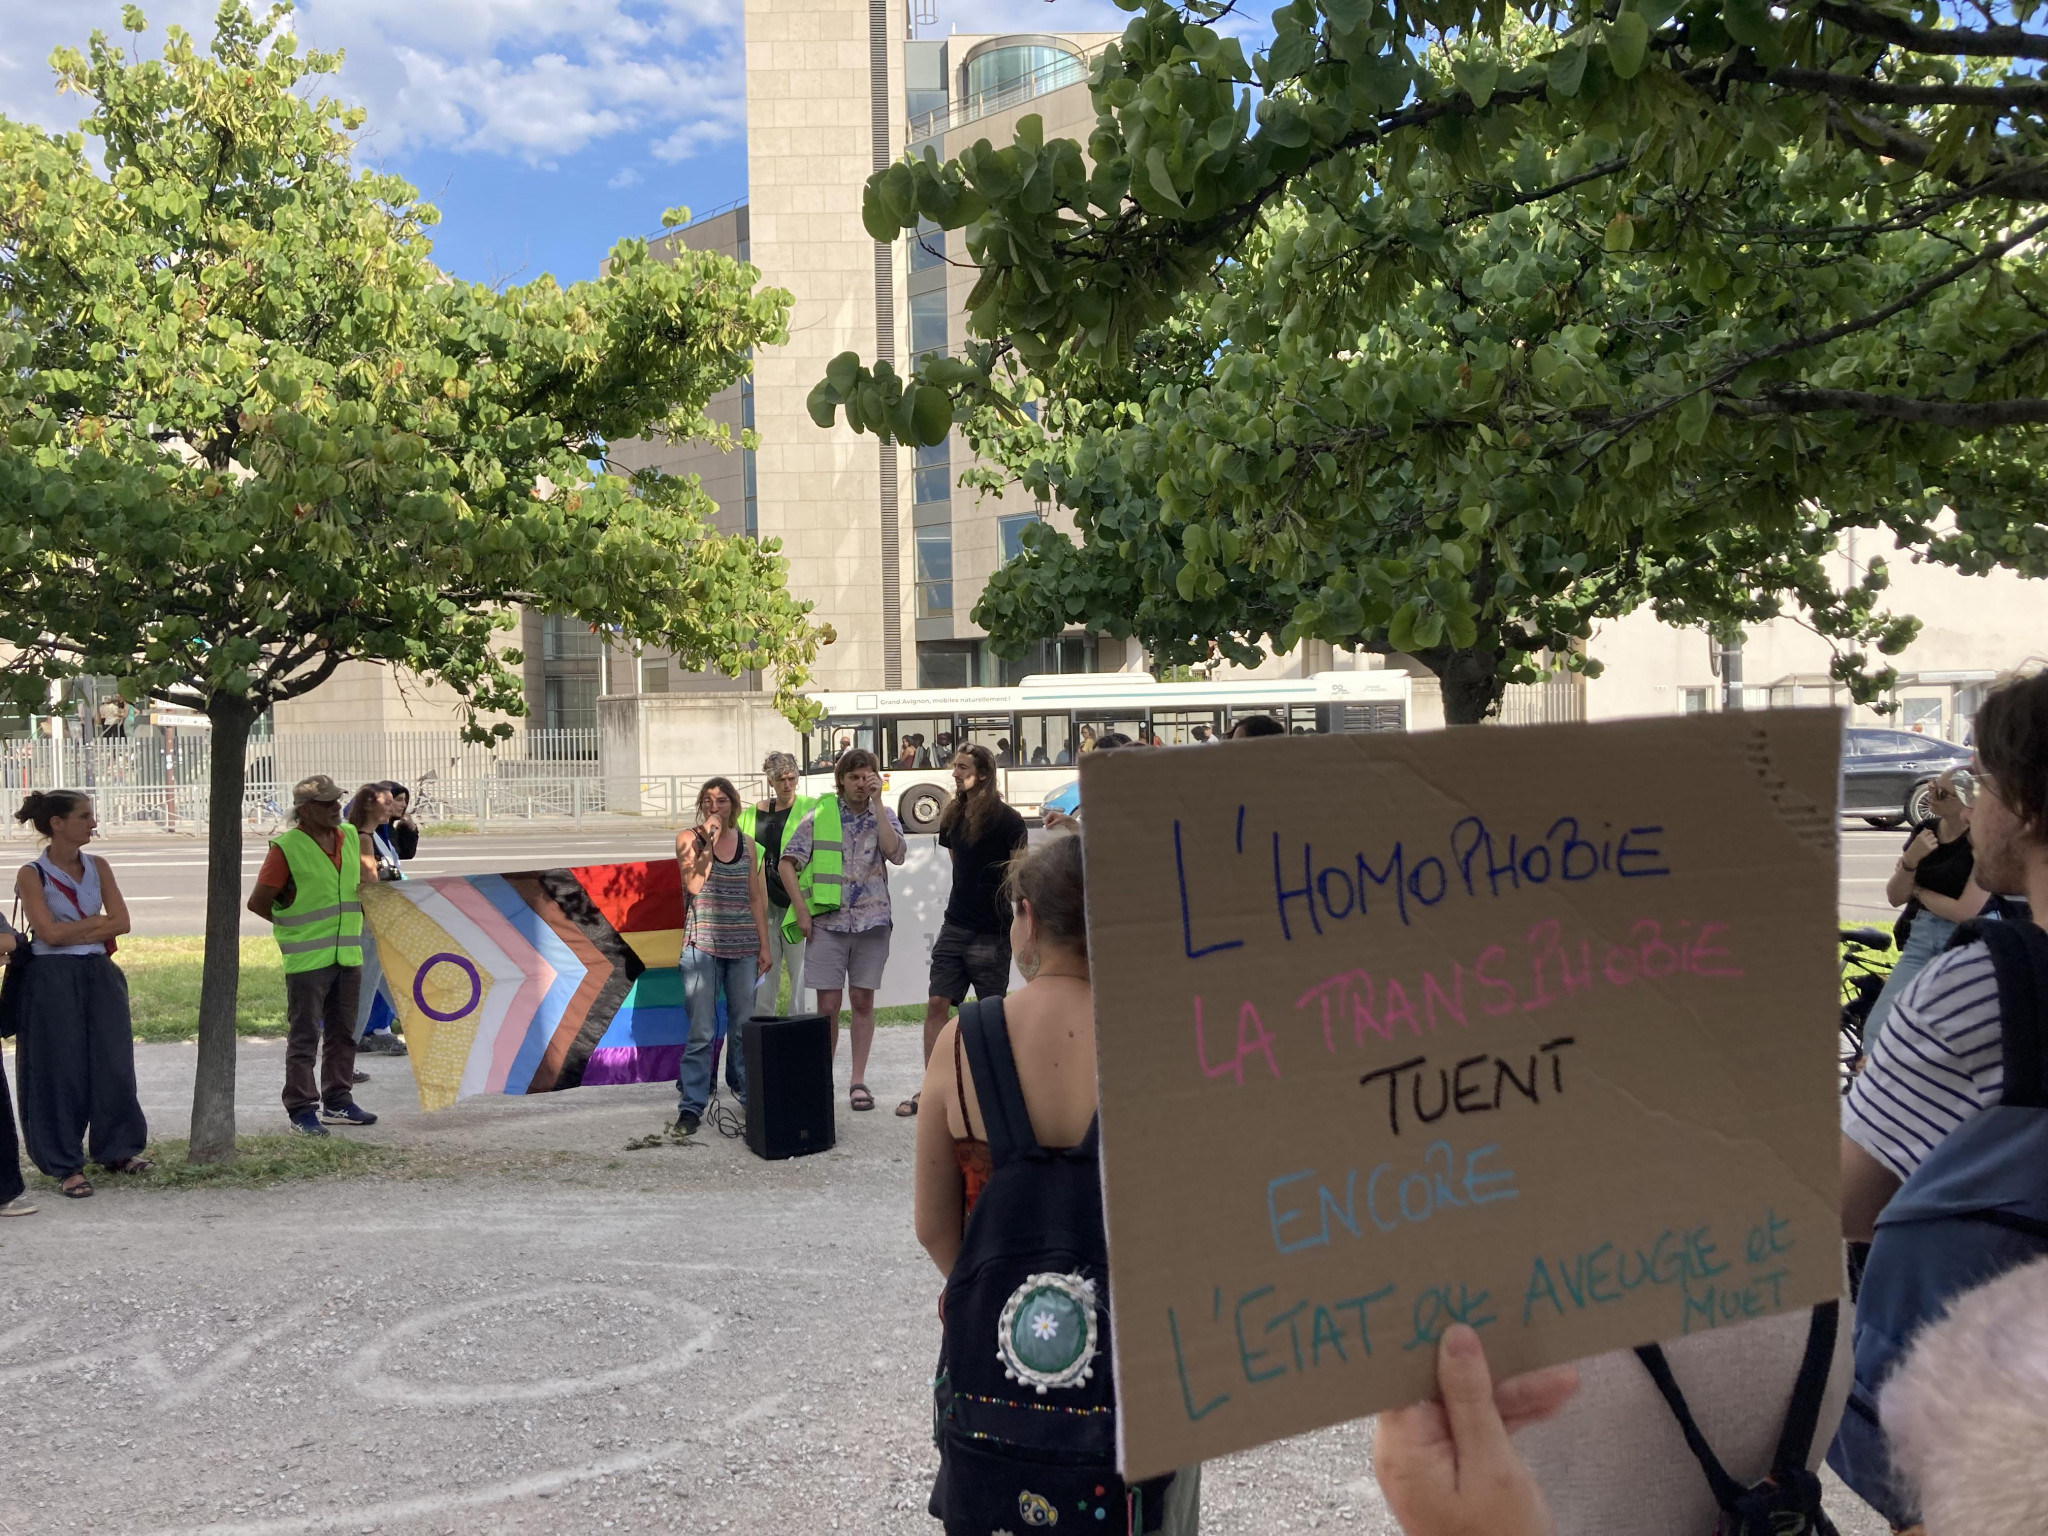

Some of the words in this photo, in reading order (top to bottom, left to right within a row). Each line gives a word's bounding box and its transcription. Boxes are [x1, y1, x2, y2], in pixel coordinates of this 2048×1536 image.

[1193, 995, 1281, 1087] LA
[1359, 1036, 1576, 1137] TUENT
[1267, 1140, 1520, 1255] ENCORE
[1168, 1283, 1396, 1422] L'ETAT
[1745, 1204, 1797, 1265] et
[1680, 1267, 1793, 1336] MUET
